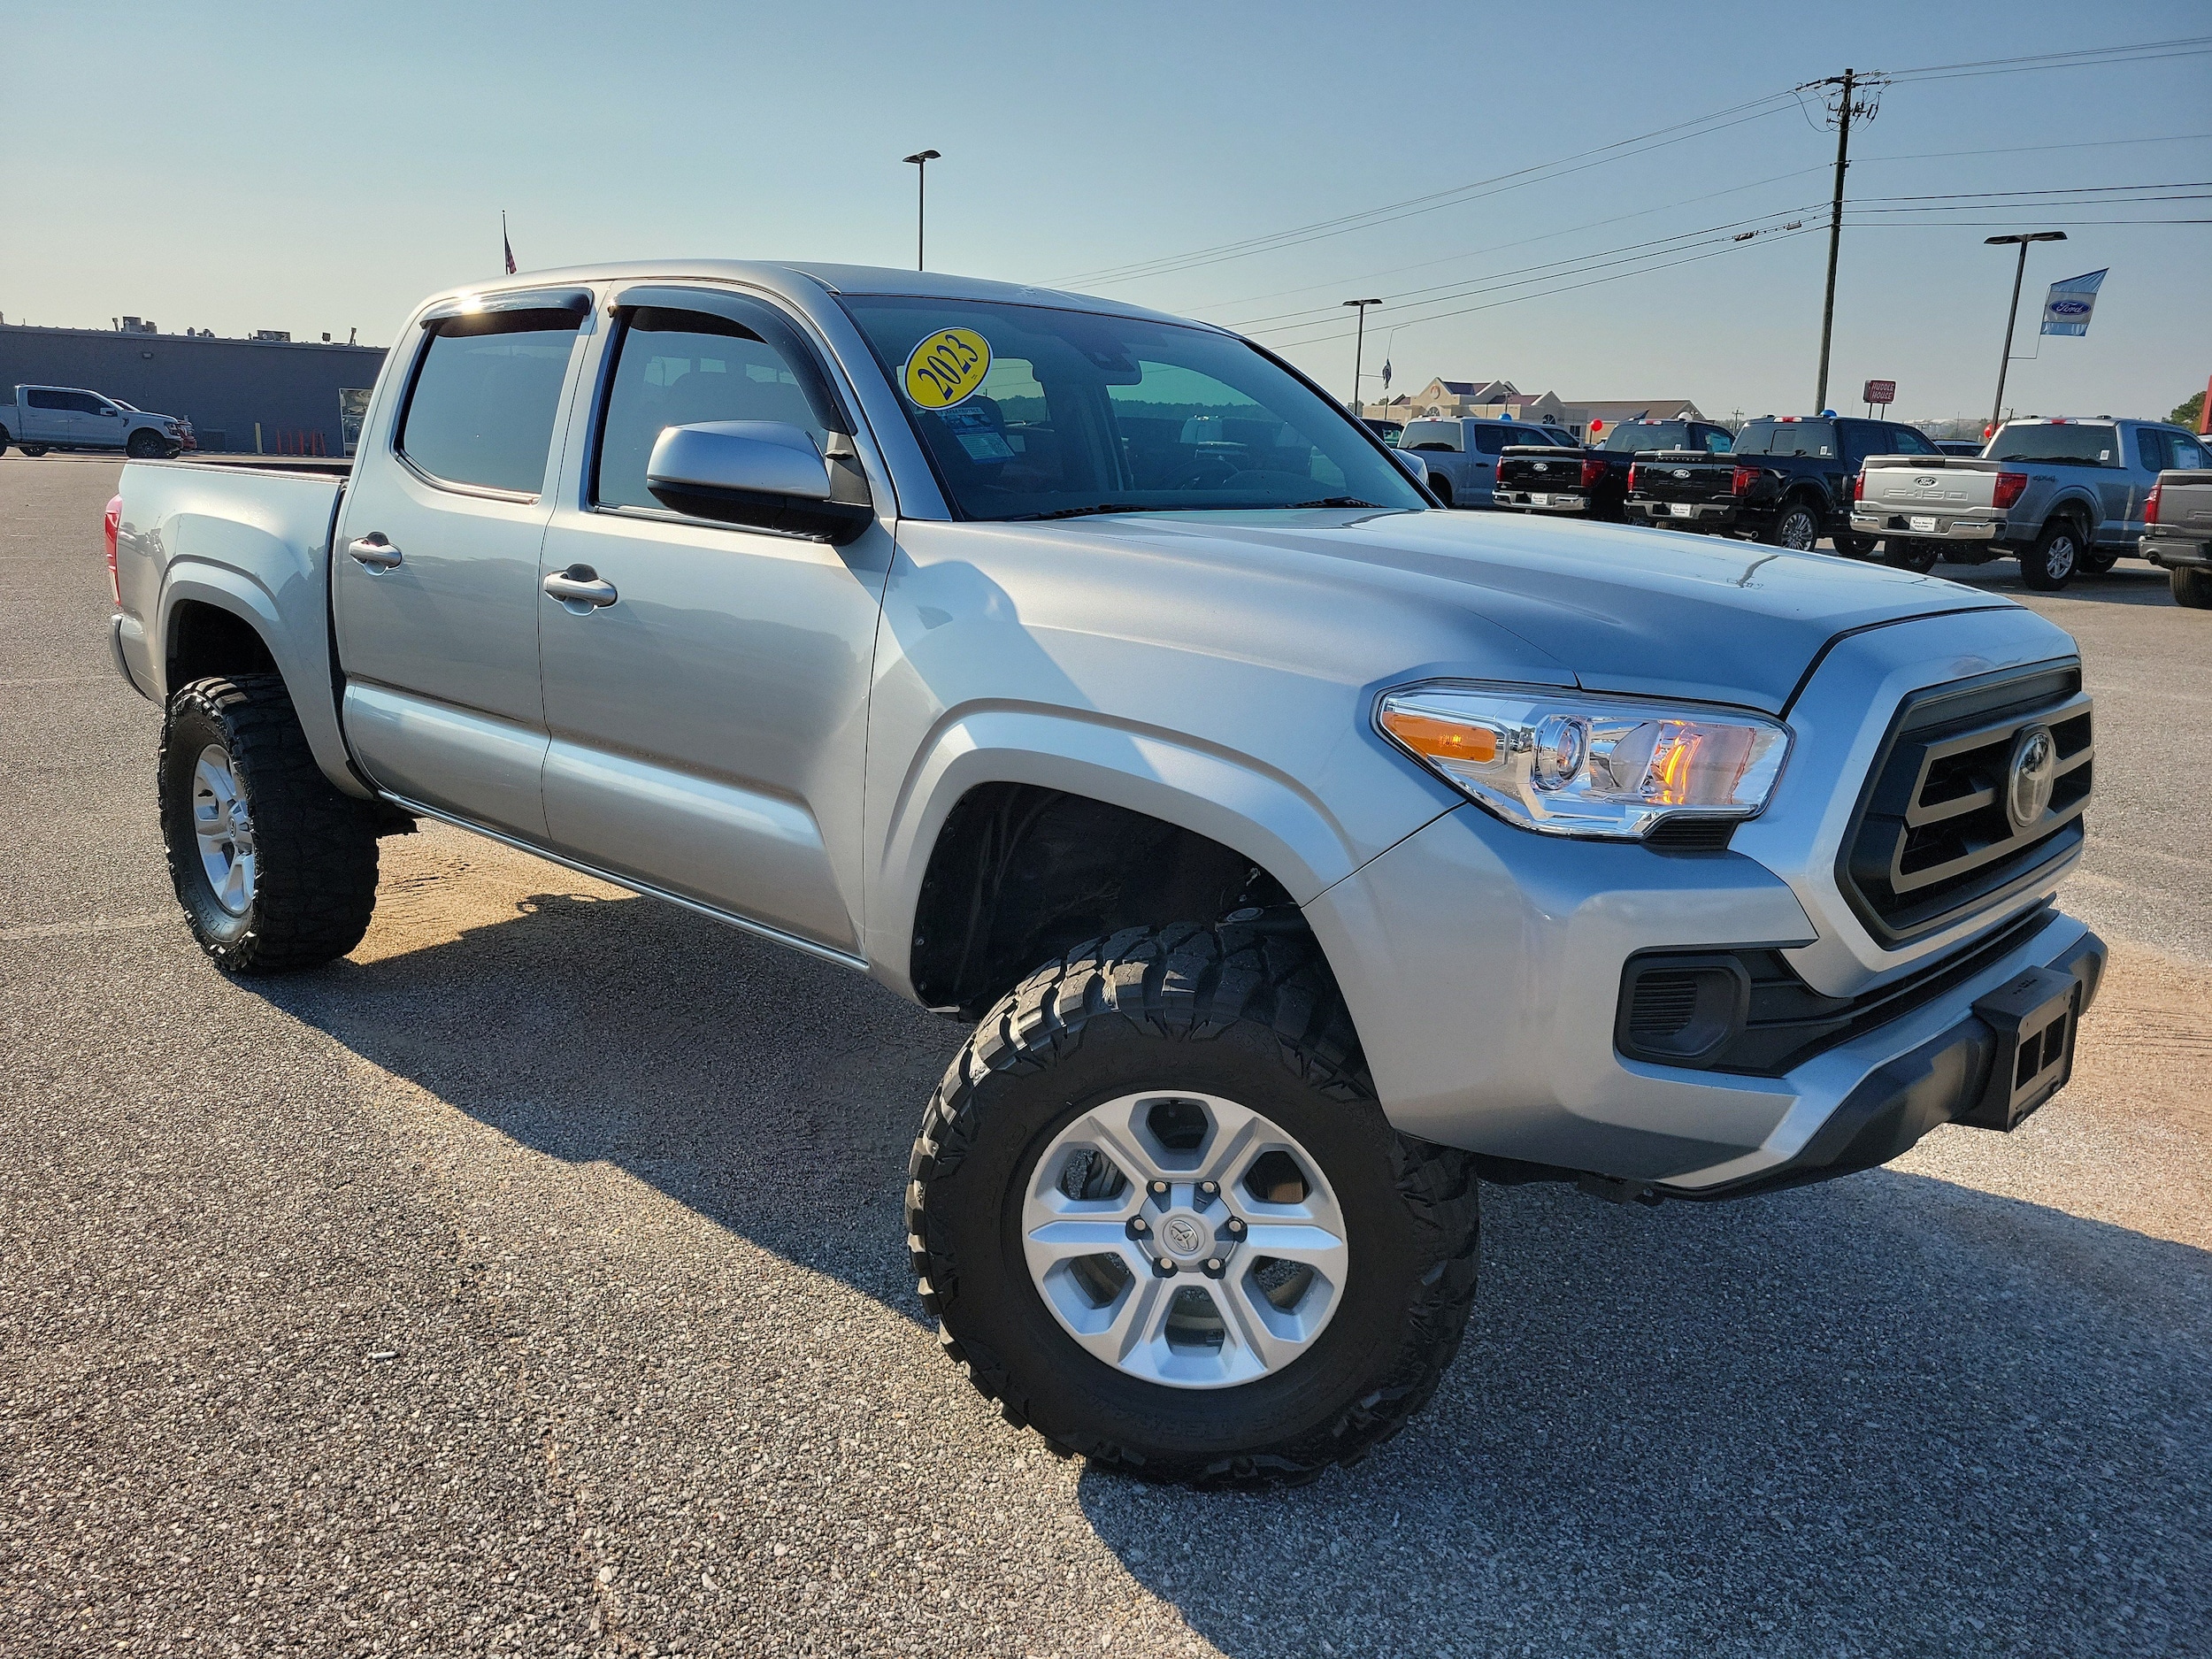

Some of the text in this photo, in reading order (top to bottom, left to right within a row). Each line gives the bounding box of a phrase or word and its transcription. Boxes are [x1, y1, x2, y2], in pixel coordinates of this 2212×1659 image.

[2056, 302, 2085, 313] Ford
[918, 334, 978, 401] 2023
[1870, 381, 1895, 391] HUDDLE
[1871, 391, 1893, 400] HOUSE
[1883, 488, 1969, 502] F-150
